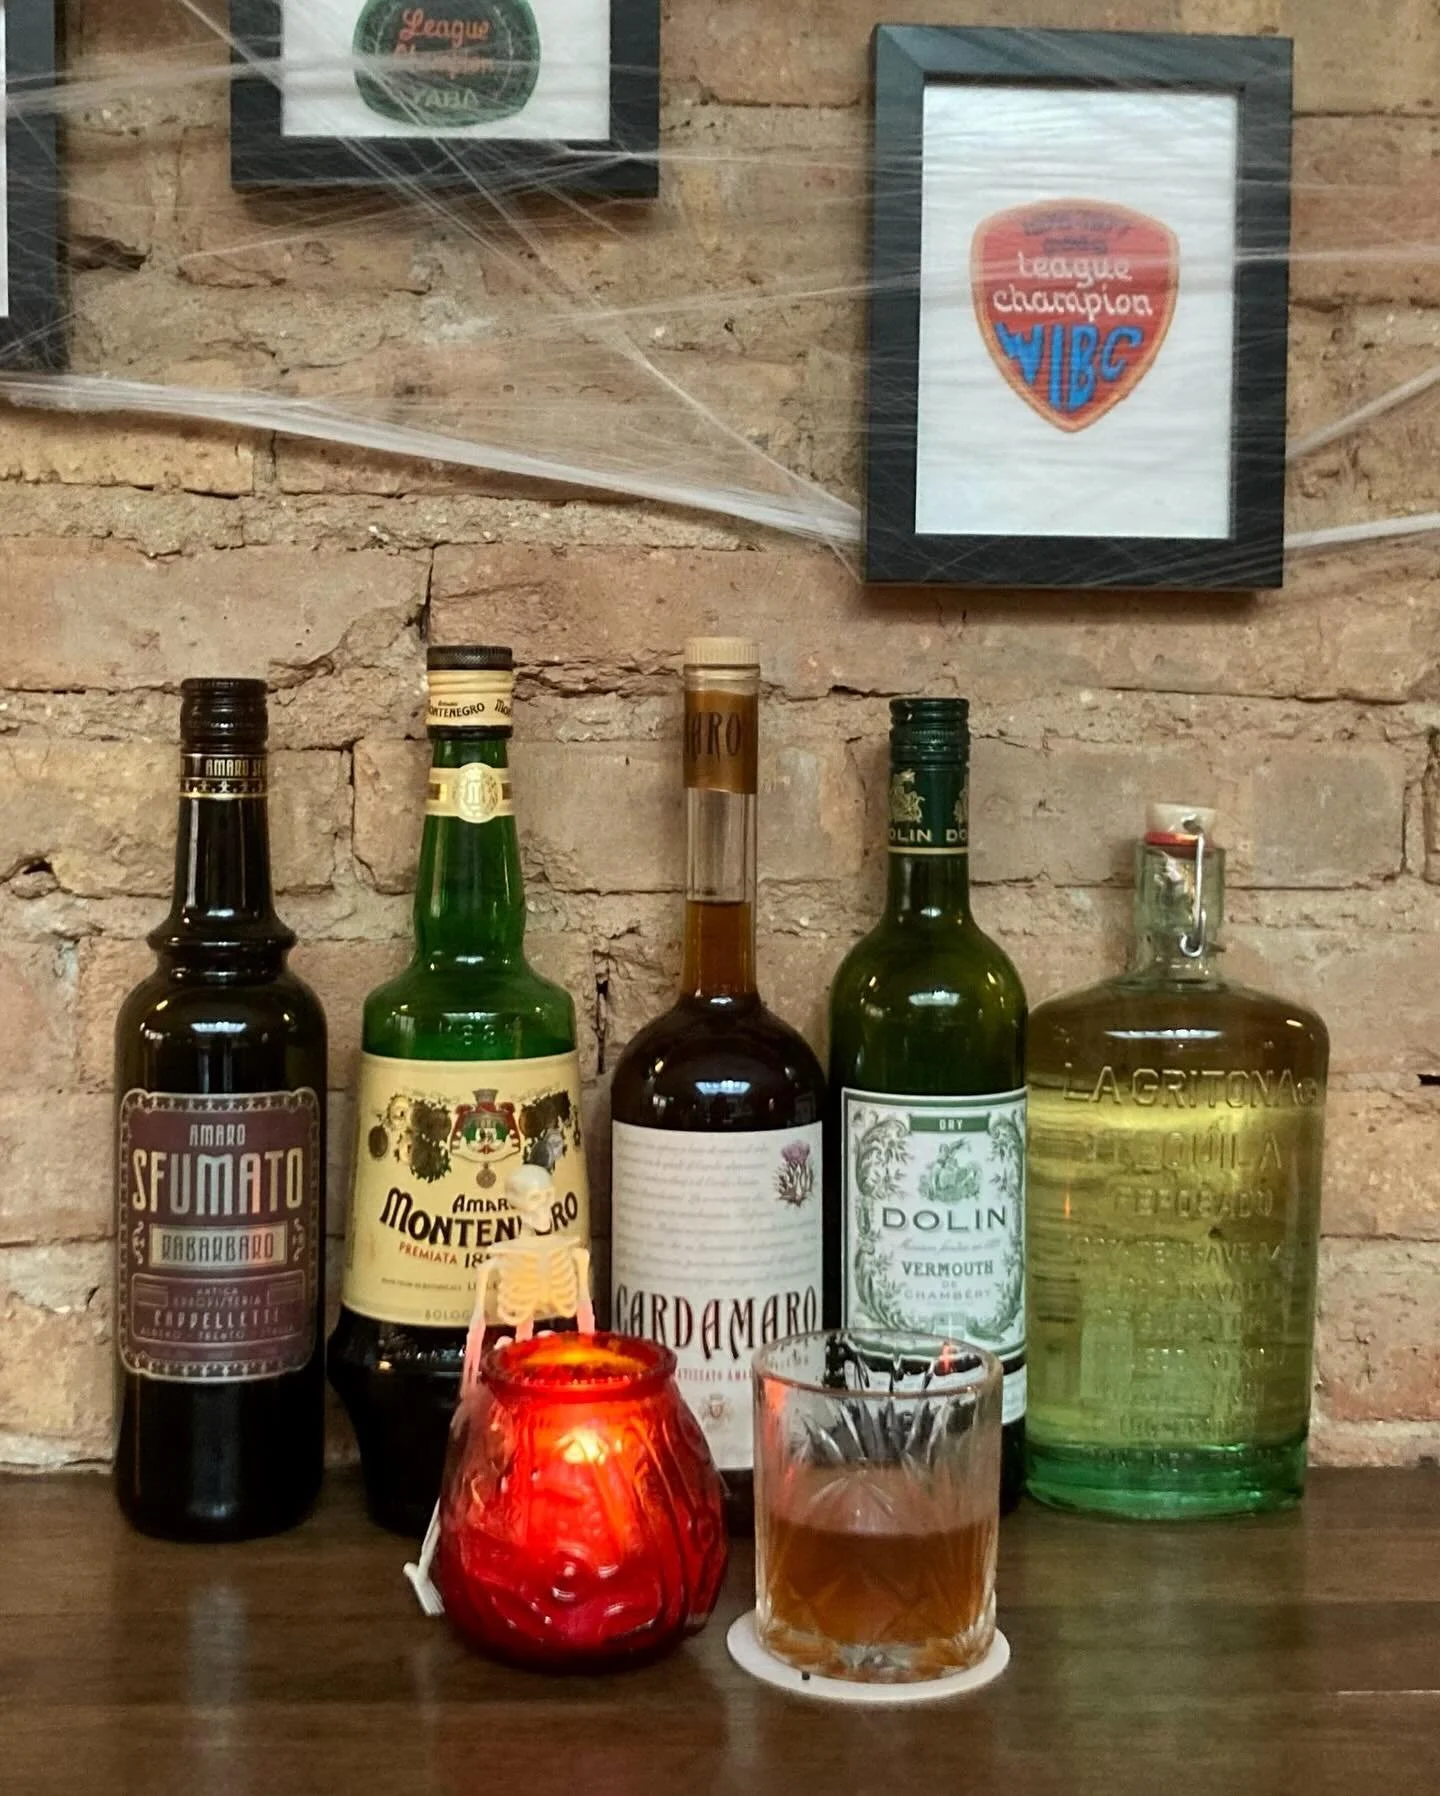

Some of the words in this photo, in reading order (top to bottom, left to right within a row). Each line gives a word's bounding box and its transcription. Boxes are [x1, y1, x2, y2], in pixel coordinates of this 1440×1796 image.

[399, 8, 490, 49] League
[992, 284, 1153, 322] champion
[994, 322, 1144, 411] WIBC
[427, 702, 485, 718] ONTENEGRO
[205, 759, 249, 776] AMARO
[190, 1123, 246, 1147] AMARO
[132, 1148, 303, 1216] SFUMATO
[452, 1194, 518, 1214] AMAR
[379, 1187, 578, 1248] MONTENRO
[882, 1207, 1006, 1231] DOLIN
[162, 1232, 274, 1262] RABARBARO
[399, 1242, 457, 1265] PREMIATA
[901, 1260, 993, 1276] VERMOUTH
[154, 1307, 279, 1329] CAPPELLETTI
[616, 1284, 816, 1359] CARDAMARO
